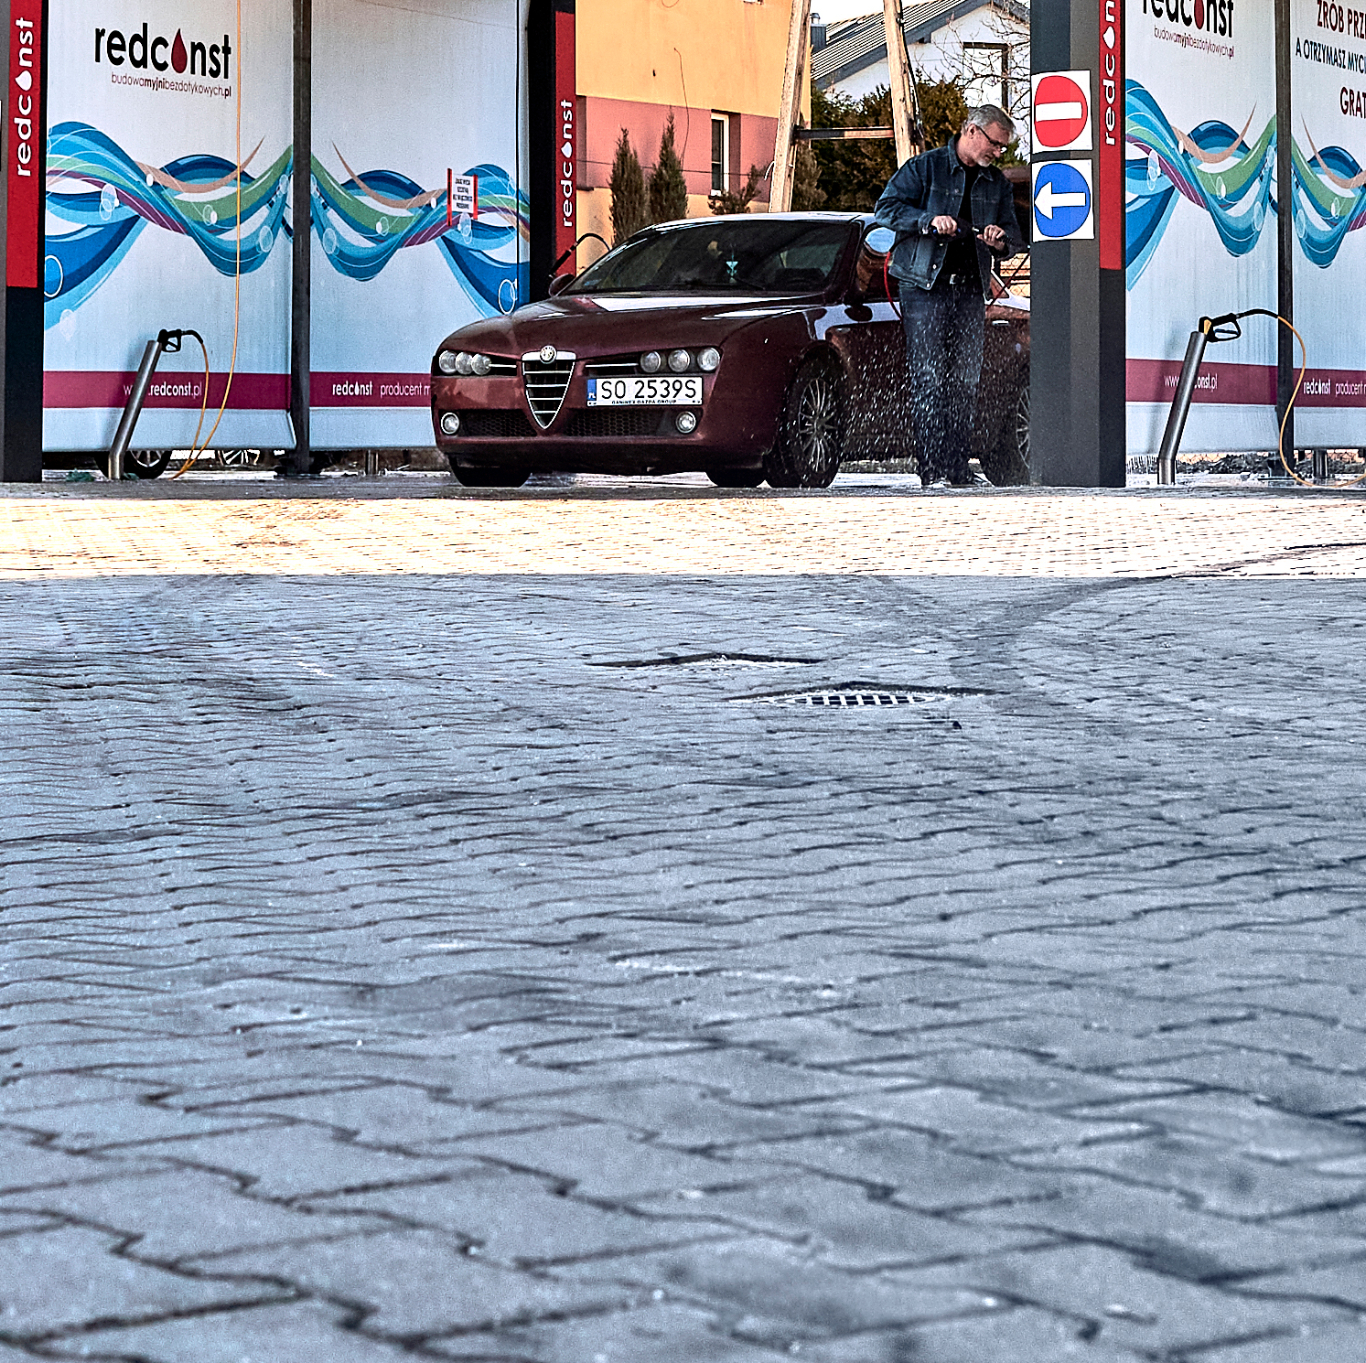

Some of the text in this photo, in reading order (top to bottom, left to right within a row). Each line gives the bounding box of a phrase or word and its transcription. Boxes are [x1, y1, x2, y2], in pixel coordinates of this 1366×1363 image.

[1296, 37, 1302, 58] A
[1303, 39, 1346, 69] OTRZYMASZ
[380, 381, 422, 398] producent
[601, 379, 696, 399] SO 2539S
